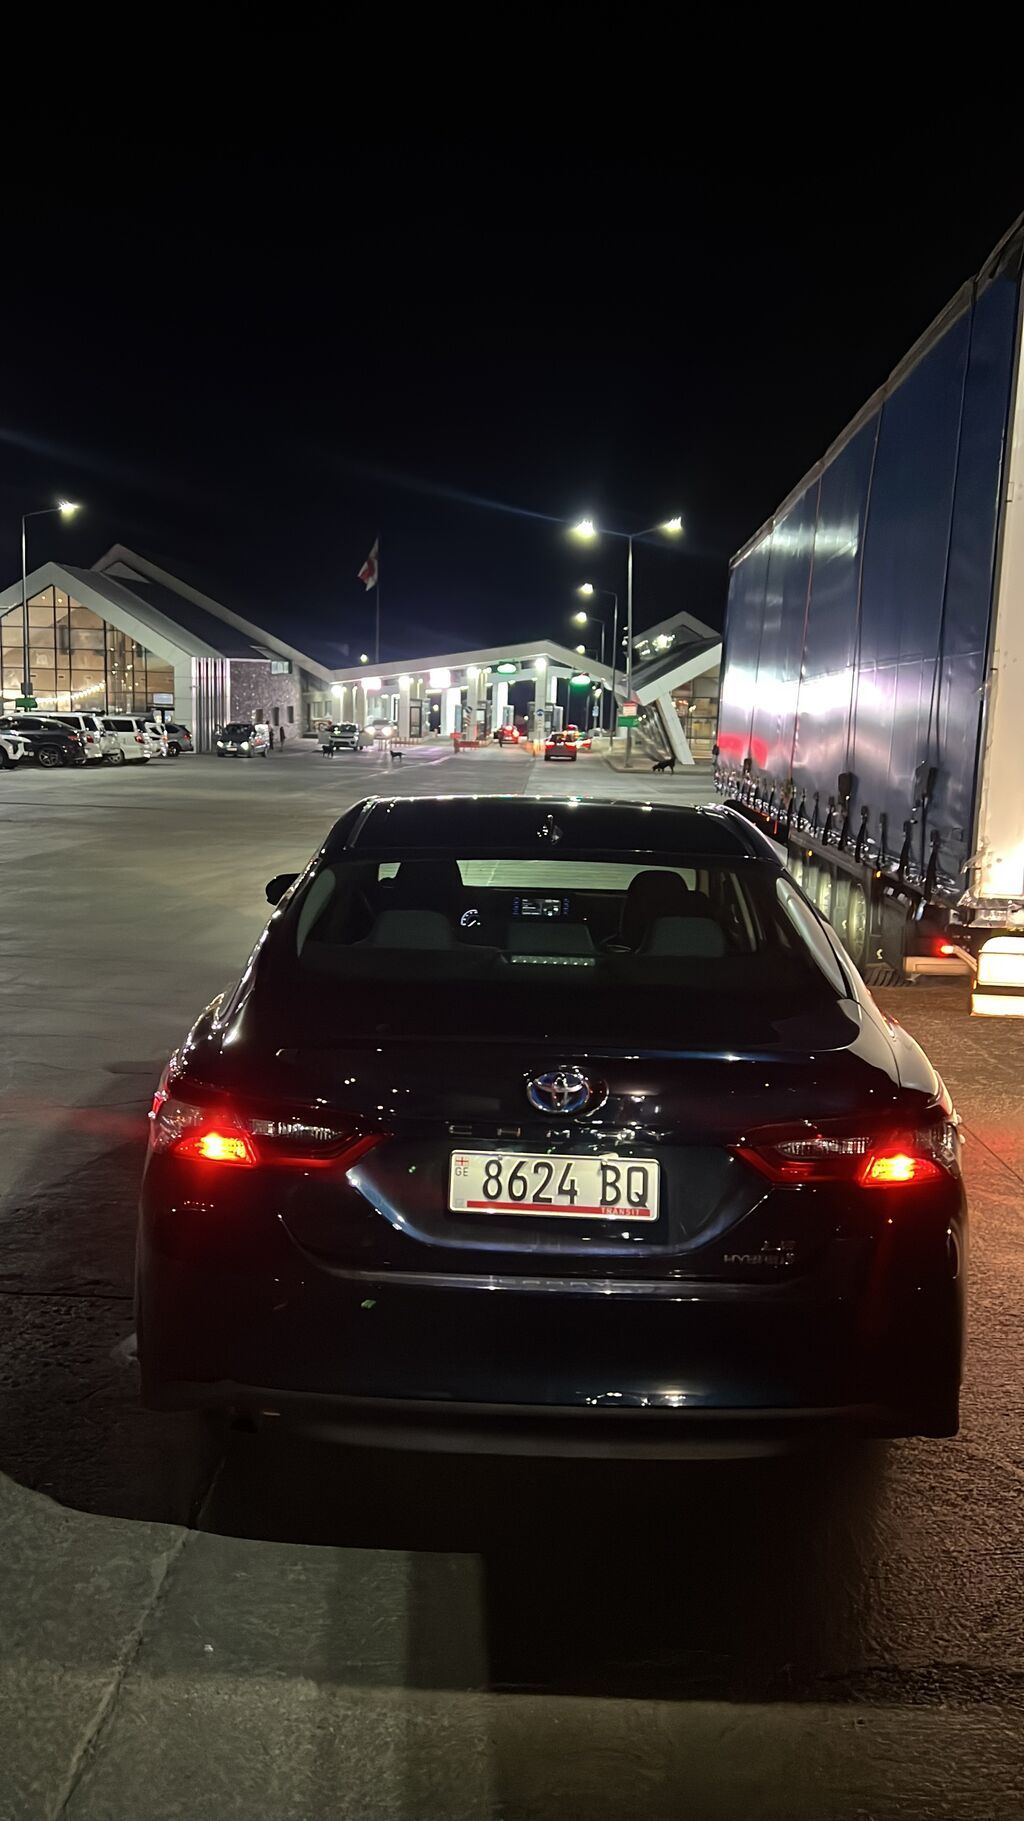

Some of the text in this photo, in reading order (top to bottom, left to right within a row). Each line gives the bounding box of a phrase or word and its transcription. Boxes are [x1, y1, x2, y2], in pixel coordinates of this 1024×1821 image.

[455, 1167, 469, 1177] GE
[482, 1159, 648, 1208] 8624 BQ
[601, 1208, 640, 1217] TRANSIT
